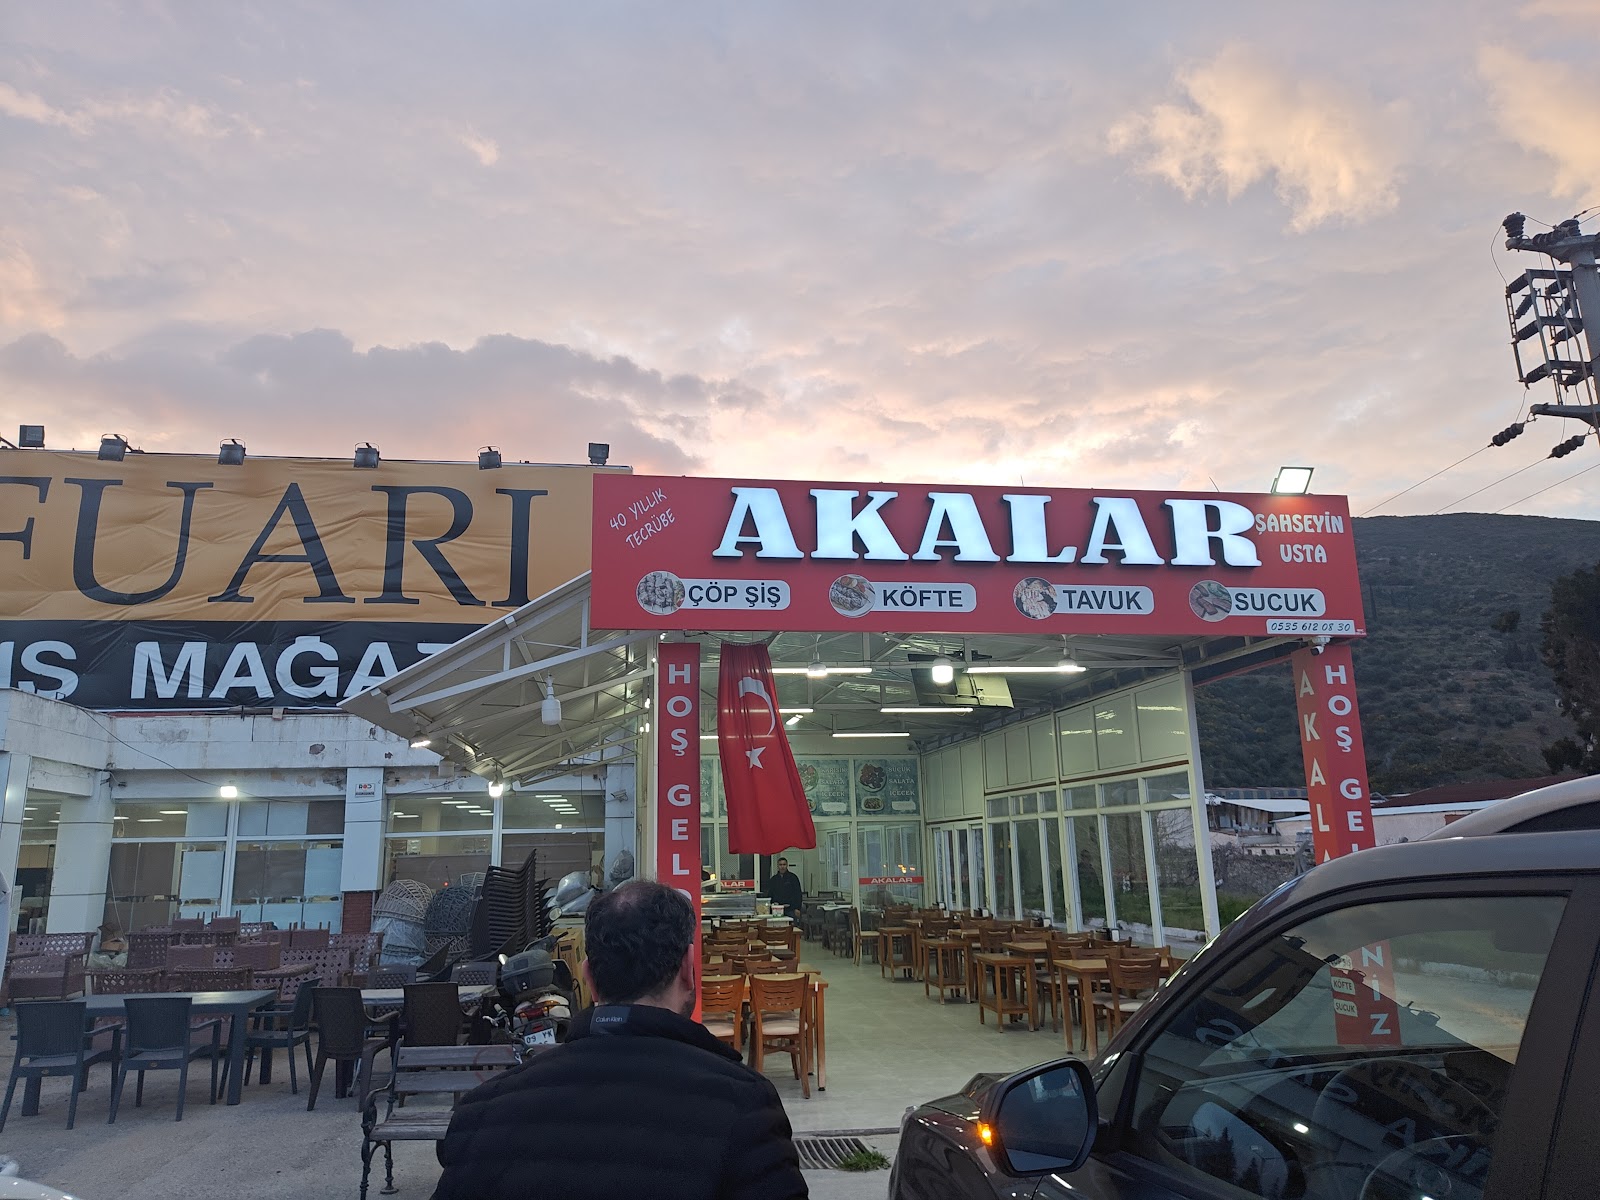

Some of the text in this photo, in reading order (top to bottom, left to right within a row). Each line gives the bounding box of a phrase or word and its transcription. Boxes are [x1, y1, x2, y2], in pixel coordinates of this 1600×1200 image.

[609, 487, 668, 530] 40 YILLIK
[625, 507, 676, 549] TECRÜBE
[712, 486, 1263, 569] AKALAR
[1254, 511, 1344, 536] ŞAHSEYİN
[1279, 543, 1328, 563] USTA
[688, 581, 781, 608] ÇÖP ŞİŞ
[882, 585, 963, 608] KÖFTE
[1062, 589, 1143, 610] TAVUK
[1234, 592, 1318, 612] SUCUK
[1270, 622, 1298, 631] 0535
[1301, 622, 1319, 631] 612
[1321, 622, 1334, 631] 08
[1337, 623, 1351, 632] 30
[1325, 665, 1353, 753] HOŞ
[666, 663, 693, 900] HOŞ GEL
[1333, 980, 1353, 991] KÖFTE
[1335, 1002, 1356, 1014] SUCUK
[526, 1035, 537, 1044] 09
